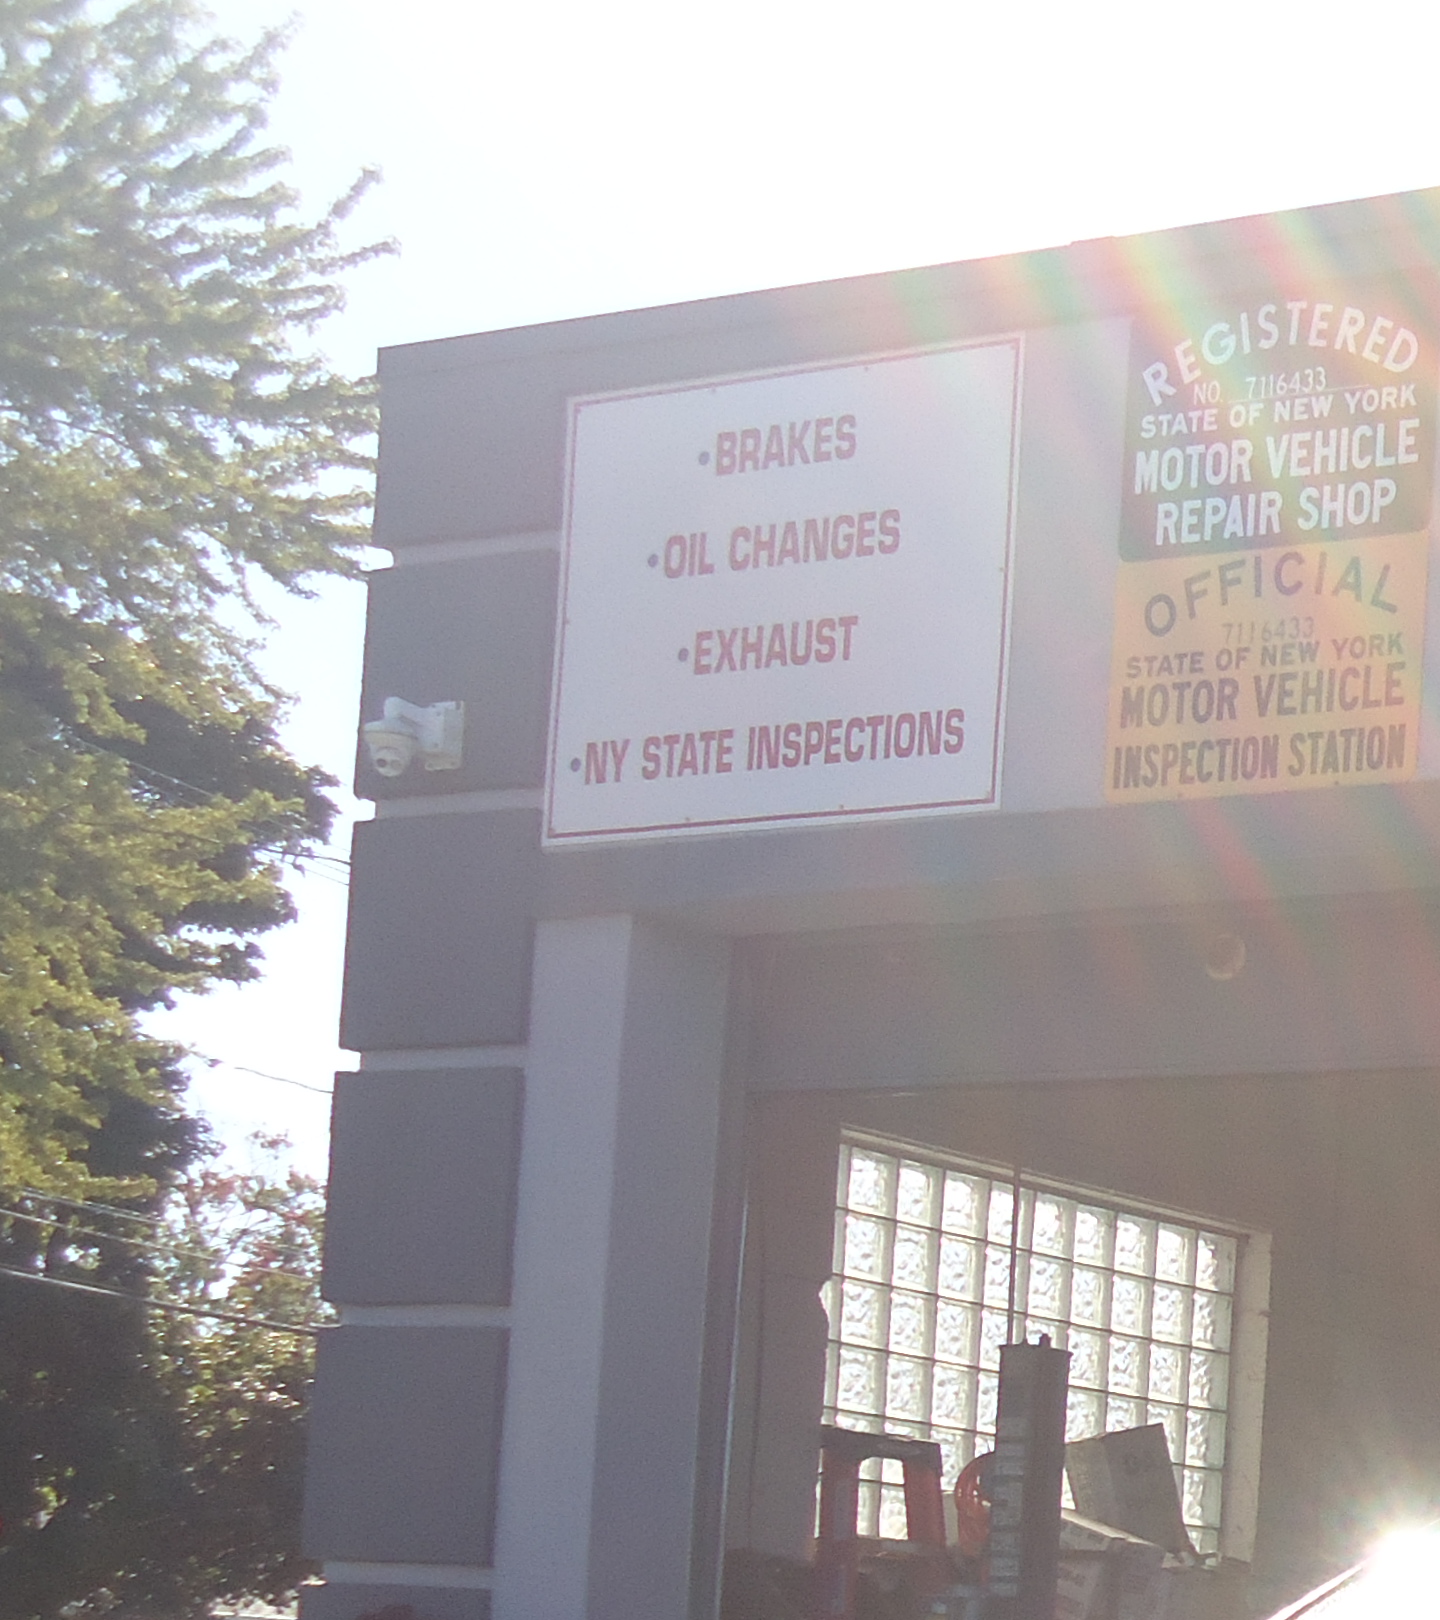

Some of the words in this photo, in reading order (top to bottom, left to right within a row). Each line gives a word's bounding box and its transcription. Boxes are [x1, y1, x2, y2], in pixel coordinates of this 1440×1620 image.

[1142, 299, 1419, 407] REGISTERED
[1193, 380, 1223, 406] NO.
[1245, 366, 1327, 400] 7116433
[1140, 408, 1218, 439] STATE
[1229, 402, 1264, 429] OF
[1273, 393, 1334, 423] NEW
[1344, 384, 1418, 415] YORK
[715, 414, 857, 477] BRAKES
[1134, 438, 1254, 495] MOTOR
[1265, 418, 1421, 479] VEHICLE
[663, 532, 715, 579] OIL
[728, 508, 901, 572] CHANGES
[1155, 490, 1284, 547] REPAIR
[1297, 478, 1397, 531] SHOP
[1144, 551, 1398, 637] OFFICIAL
[692, 615, 859, 676] EXHAUST
[1126, 650, 1204, 679] STATE
[1215, 646, 1250, 672] OF
[1260, 640, 1320, 667] NEW
[1331, 632, 1405, 661] YORK
[1222, 616, 1316, 644] 7116433
[1120, 677, 1240, 729] MOTOR
[1253, 661, 1407, 718] VEHICLE
[584, 738, 632, 786] NY
[641, 728, 734, 781] STATE
[746, 708, 965, 772] INSPECTIONS
[1112, 734, 1279, 790] INSPECTION
[1288, 723, 1407, 777] STATION
